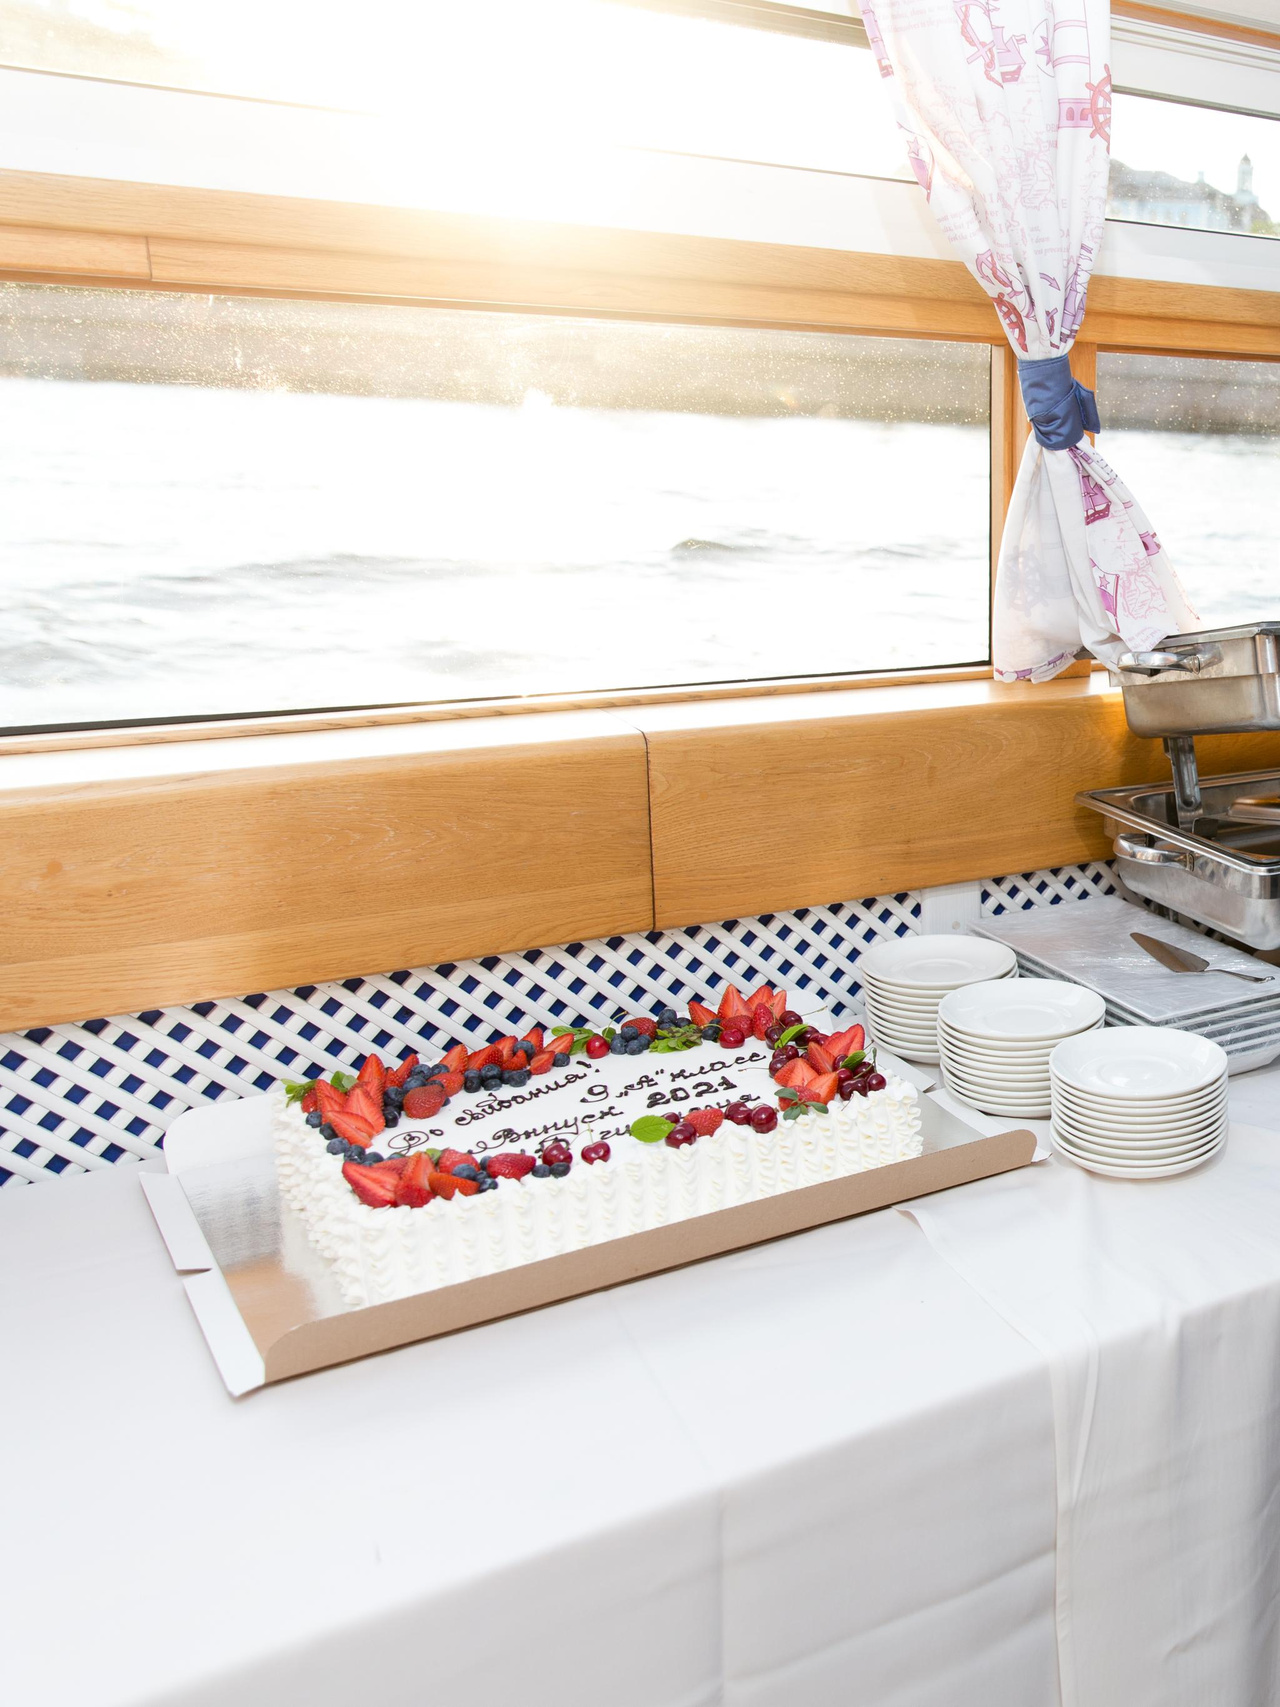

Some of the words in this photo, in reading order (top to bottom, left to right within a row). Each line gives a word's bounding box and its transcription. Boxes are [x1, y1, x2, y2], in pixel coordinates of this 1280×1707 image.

[580, 1084, 609, 1103] 9
[670, 1052, 767, 1082] класс
[646, 1075, 737, 1108] 2021
